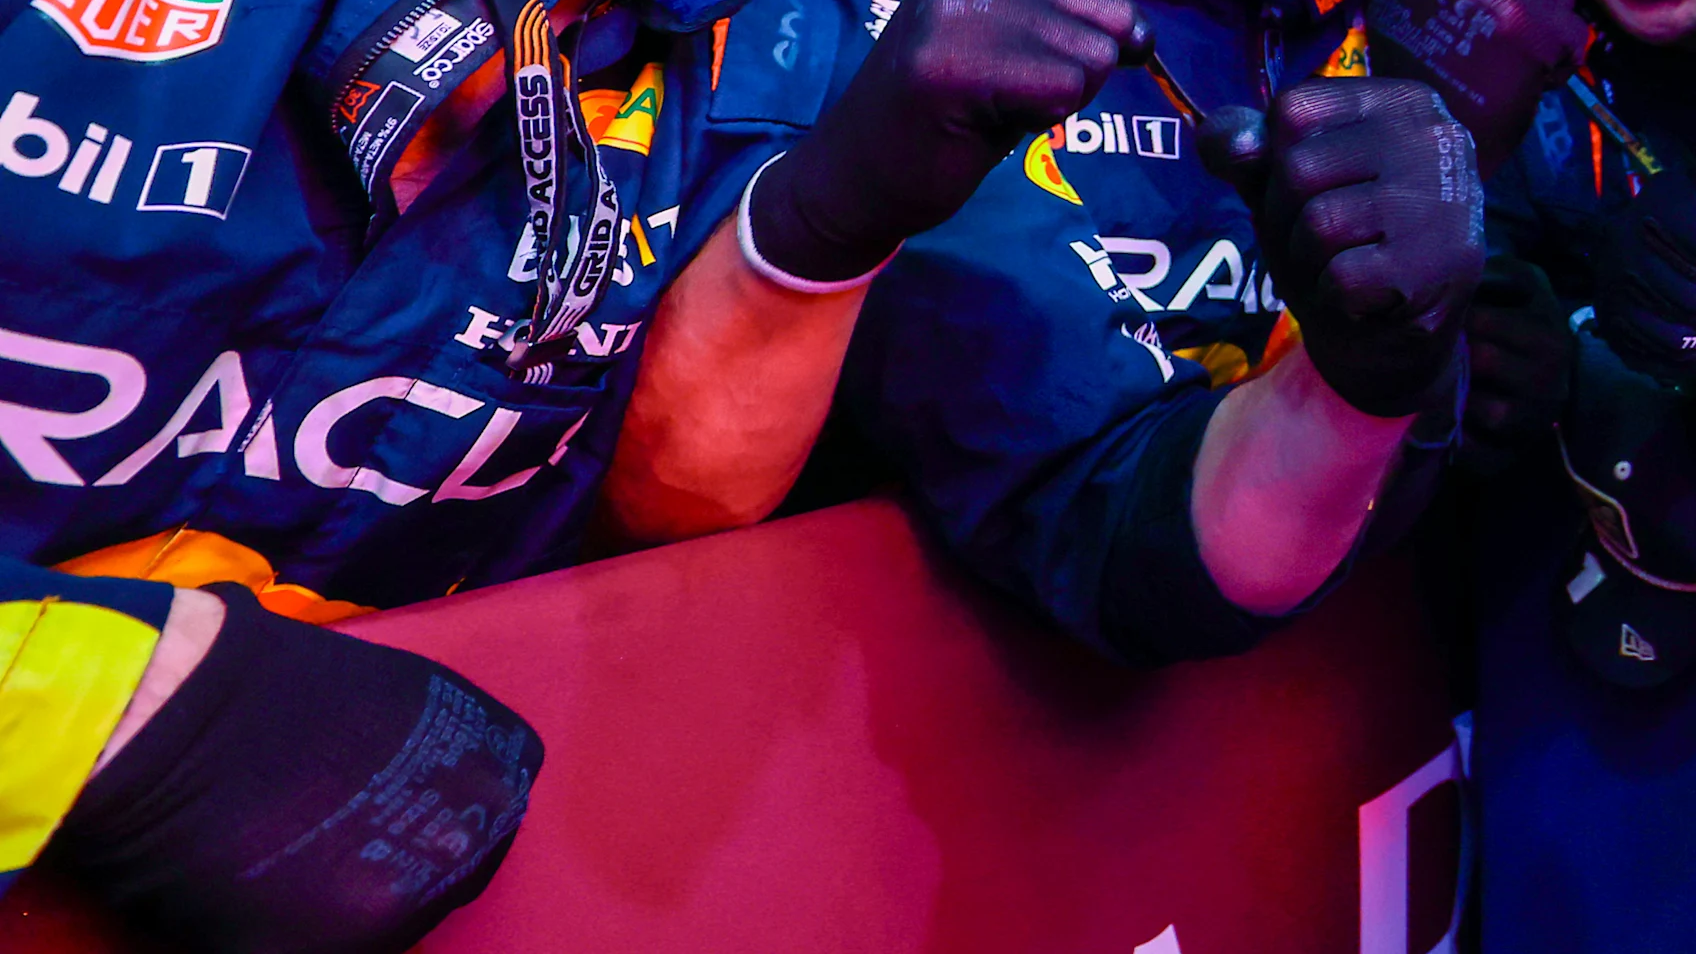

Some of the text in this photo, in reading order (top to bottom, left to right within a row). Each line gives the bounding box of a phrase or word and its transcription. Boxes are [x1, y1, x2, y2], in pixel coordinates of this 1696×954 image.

[421, 21, 496, 83] sparco
[0, 90, 219, 206] bil 1
[519, 74, 553, 204] ACCESS
[1144, 120, 1164, 154] 1
[573, 219, 613, 297] GRID
